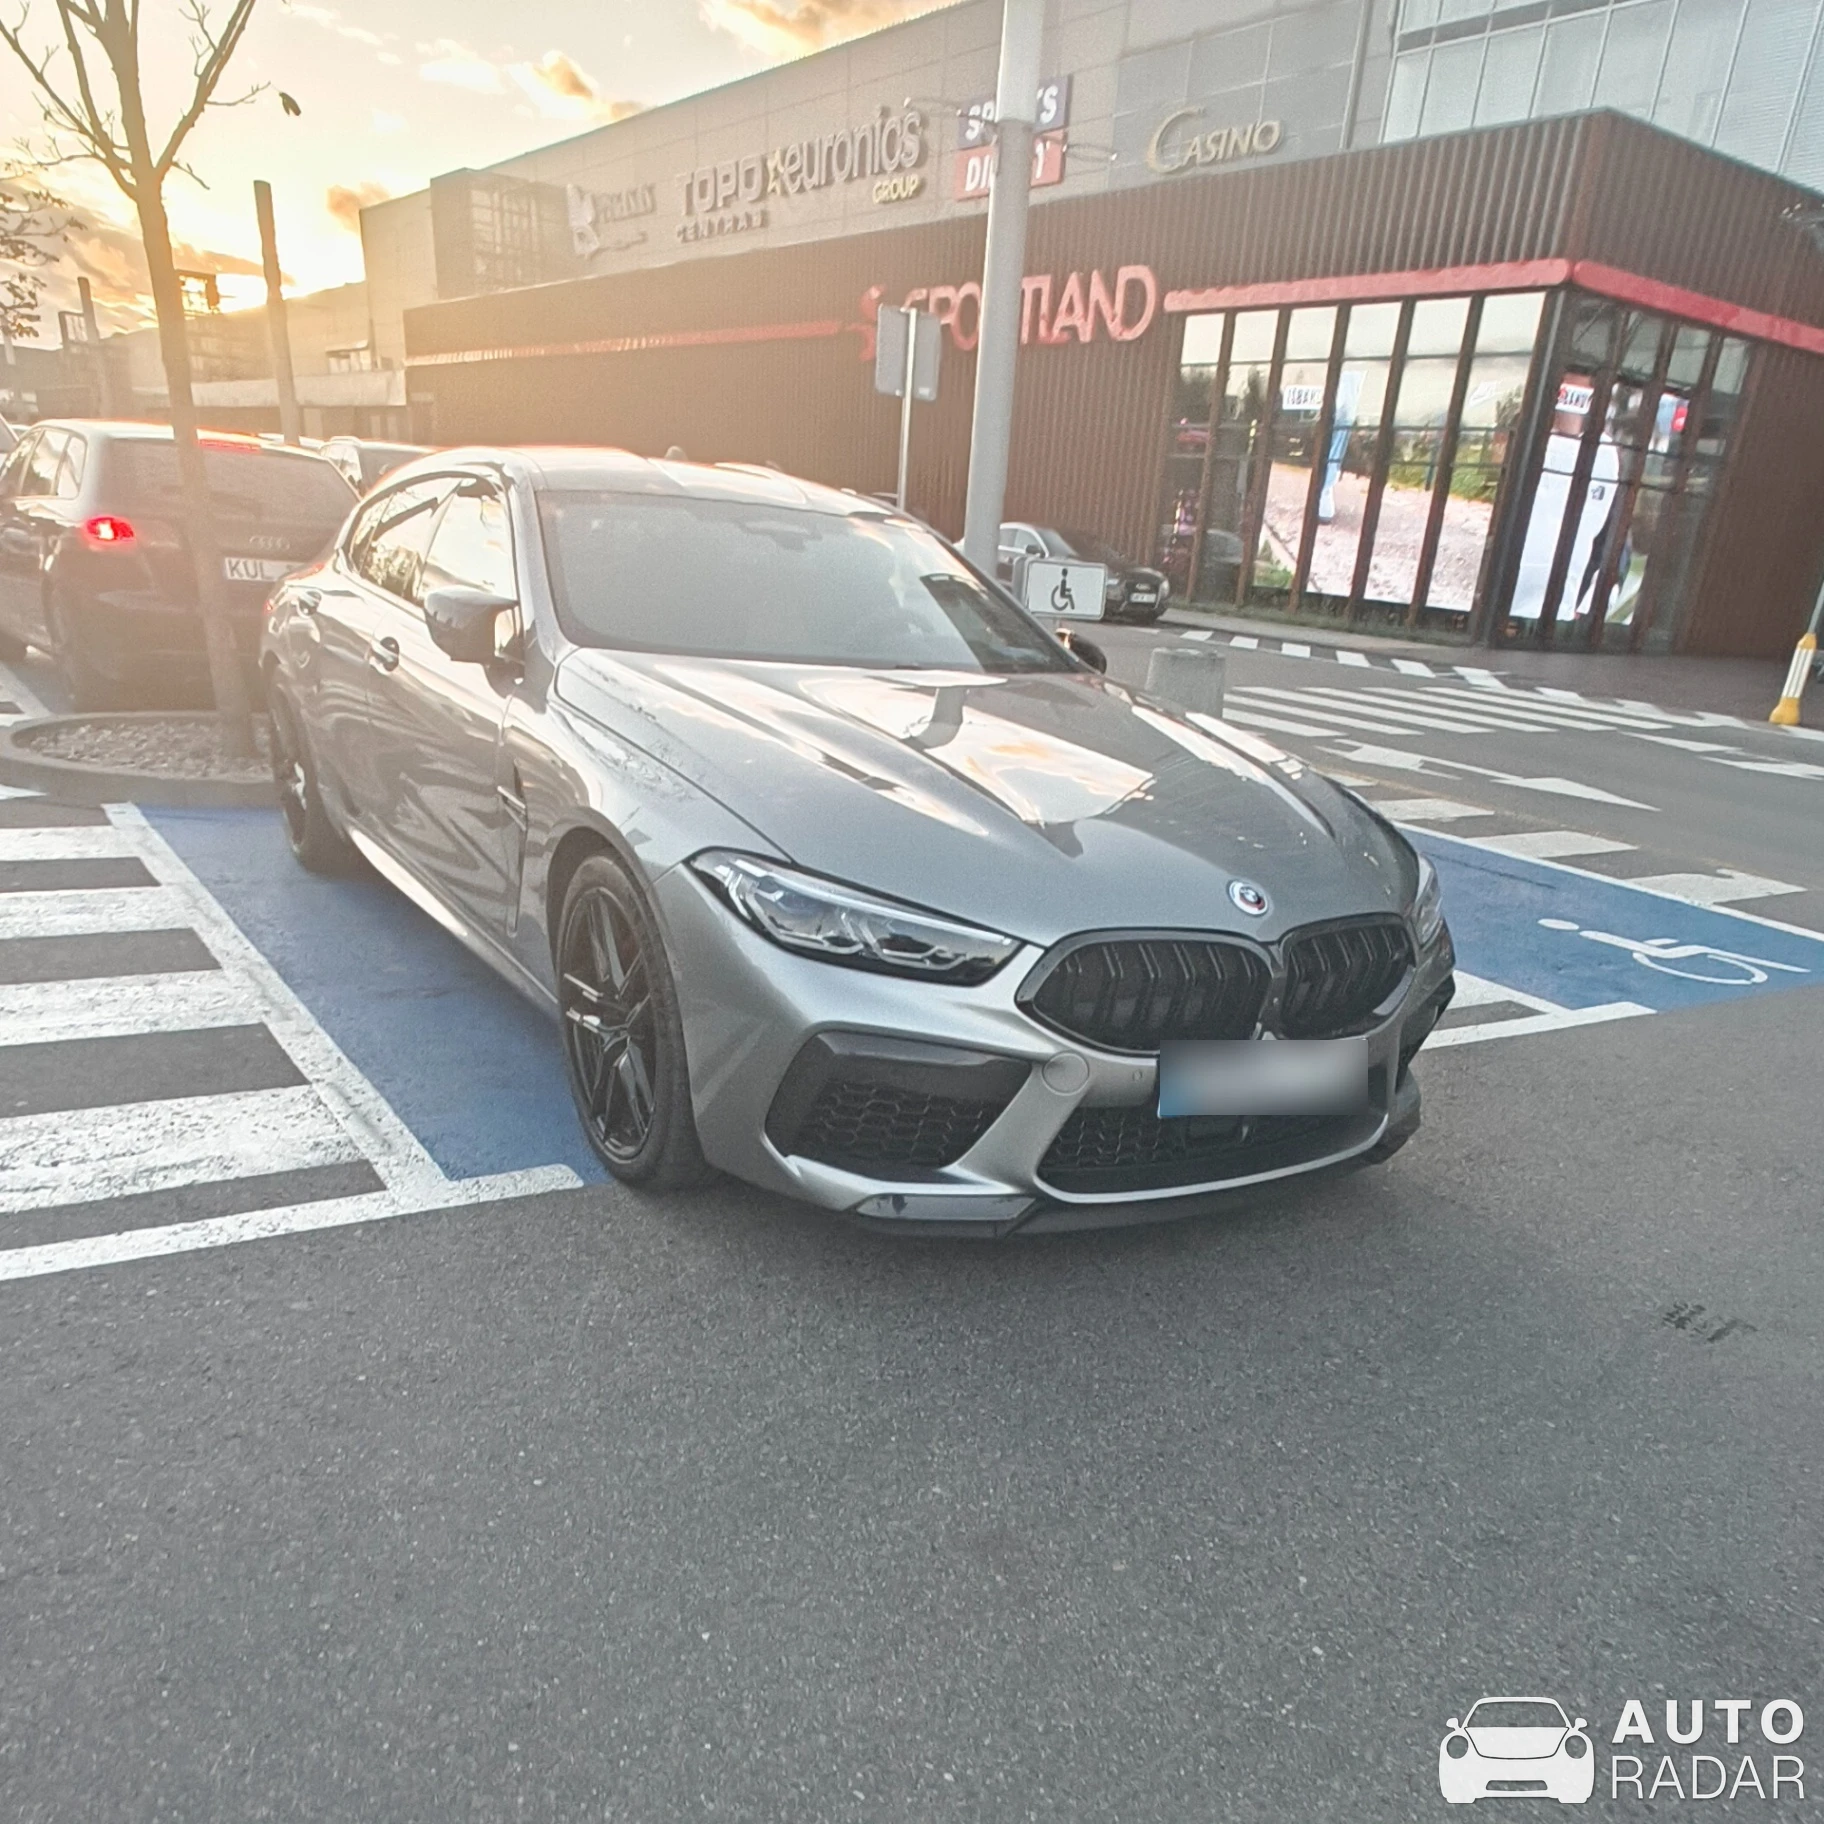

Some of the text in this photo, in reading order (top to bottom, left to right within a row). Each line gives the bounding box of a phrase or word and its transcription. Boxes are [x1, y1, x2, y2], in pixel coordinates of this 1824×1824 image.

[782, 105, 922, 194] euronics
[1147, 105, 1282, 173] CASINO
[676, 155, 763, 217] TOPO
[872, 173, 921, 204] GROUP
[227, 559, 275, 580] KUL
